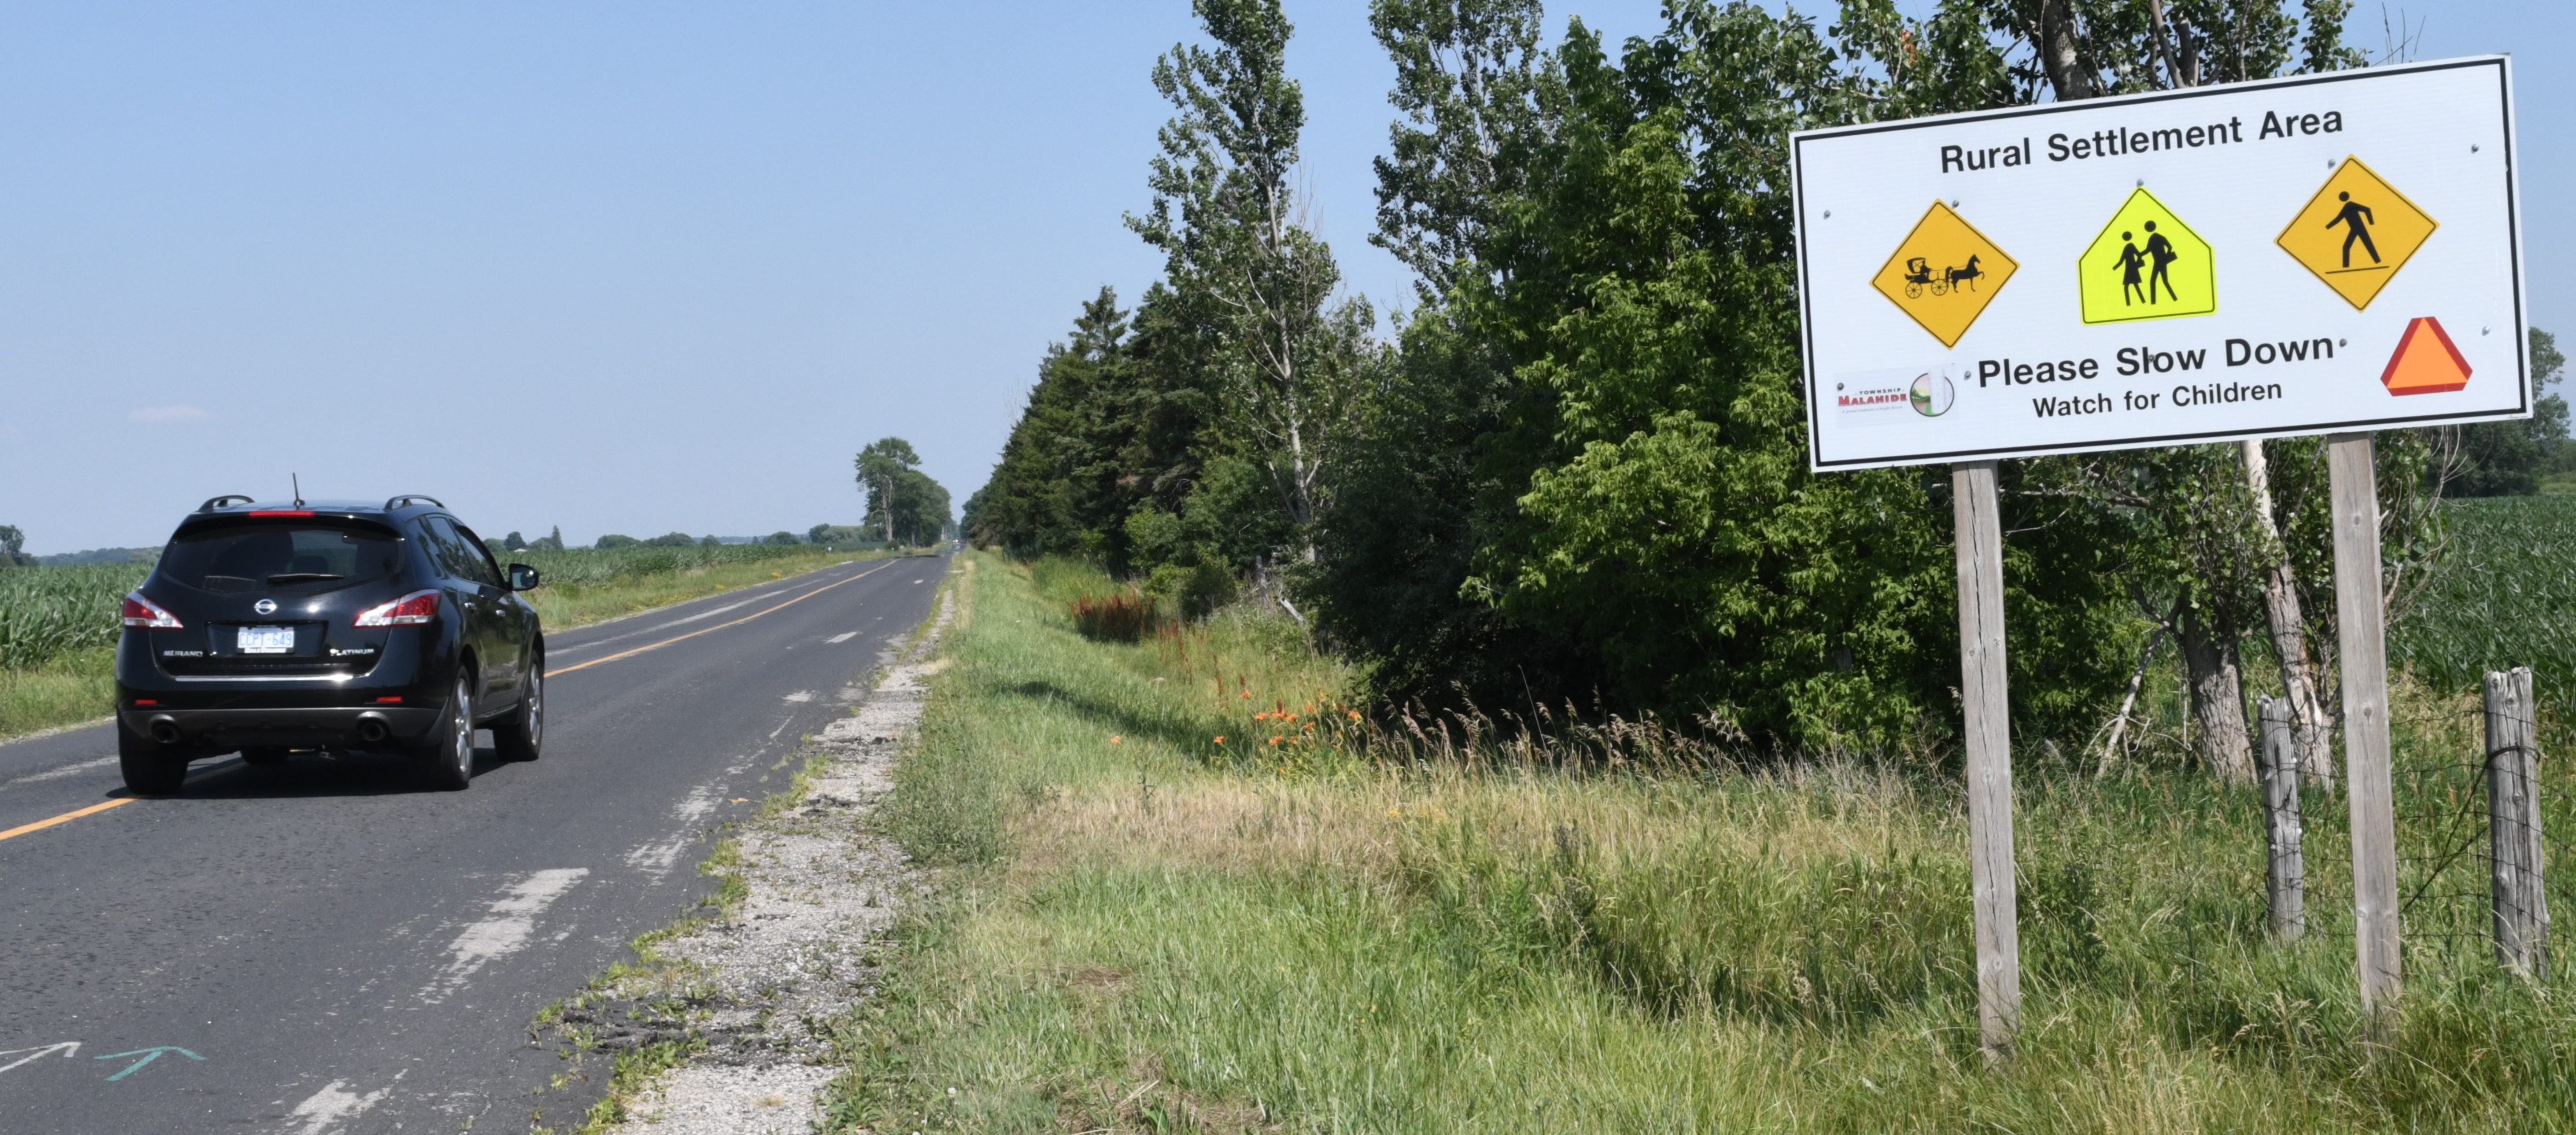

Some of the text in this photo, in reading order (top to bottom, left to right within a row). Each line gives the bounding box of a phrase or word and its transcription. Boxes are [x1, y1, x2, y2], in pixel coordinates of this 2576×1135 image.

[1941, 110, 2342, 174] Rural Settlement Area
[1979, 338, 2333, 388] Please Slow Down
[1838, 393, 1907, 407] MALAHIDE
[2032, 382, 2282, 418] Watch for Children
[239, 632, 292, 646] CCPT 649
